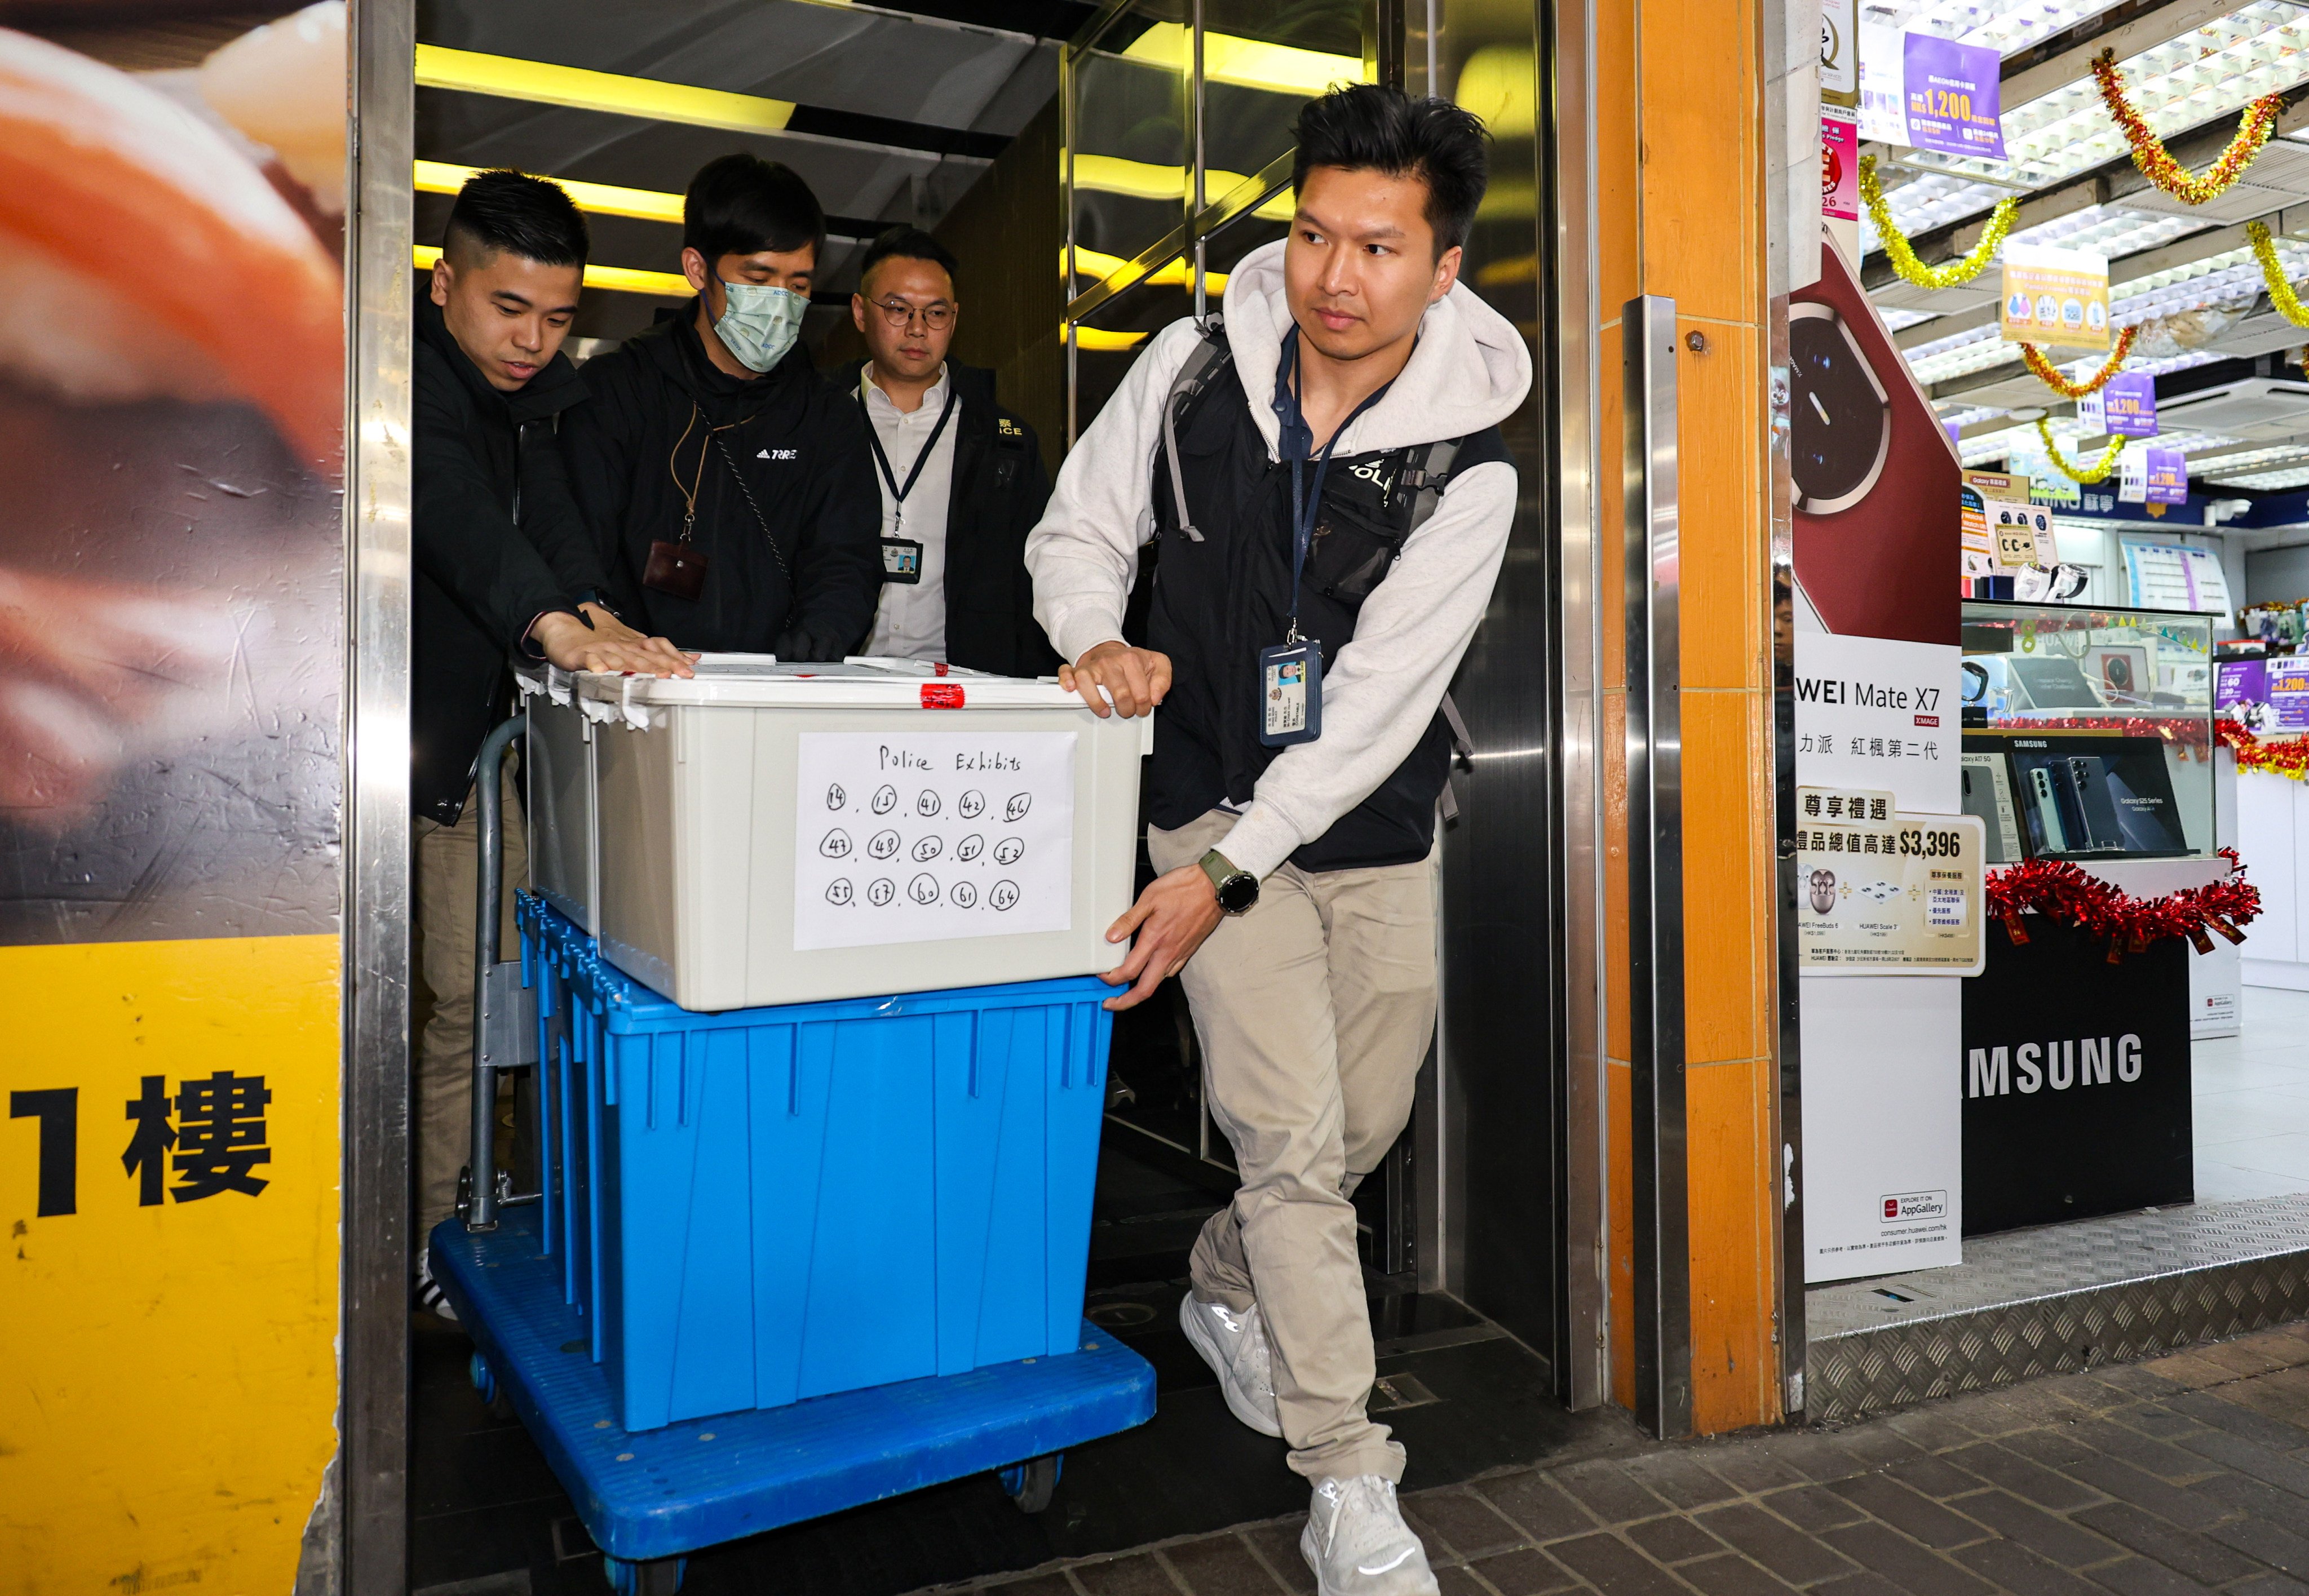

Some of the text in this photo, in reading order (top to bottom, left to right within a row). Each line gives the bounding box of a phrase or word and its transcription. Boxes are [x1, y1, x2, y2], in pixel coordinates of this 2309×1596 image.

[1925, 88, 1971, 121] 1,200
[1827, 134, 1844, 143] Pledge
[1822, 180, 1836, 194] KES
[1973, 477, 1989, 486] Galaxy
[1795, 677, 1940, 711] WEI Mate X7
[1916, 717, 1938, 725] XMAGE
[1799, 733, 1939, 761] 力派 紅楓第二代
[2014, 739, 2047, 748] SAMSUNG
[878, 744, 1023, 772] Police Exhibits
[1804, 794, 1887, 820] 尊享禮遇
[1900, 828, 1960, 860] $3,396
[1962, 1034, 2142, 1100] MSUNG
[1901, 1203, 1943, 1216] AppGallery
[1881, 1223, 1947, 1236] consumer.huawei.com/hk
